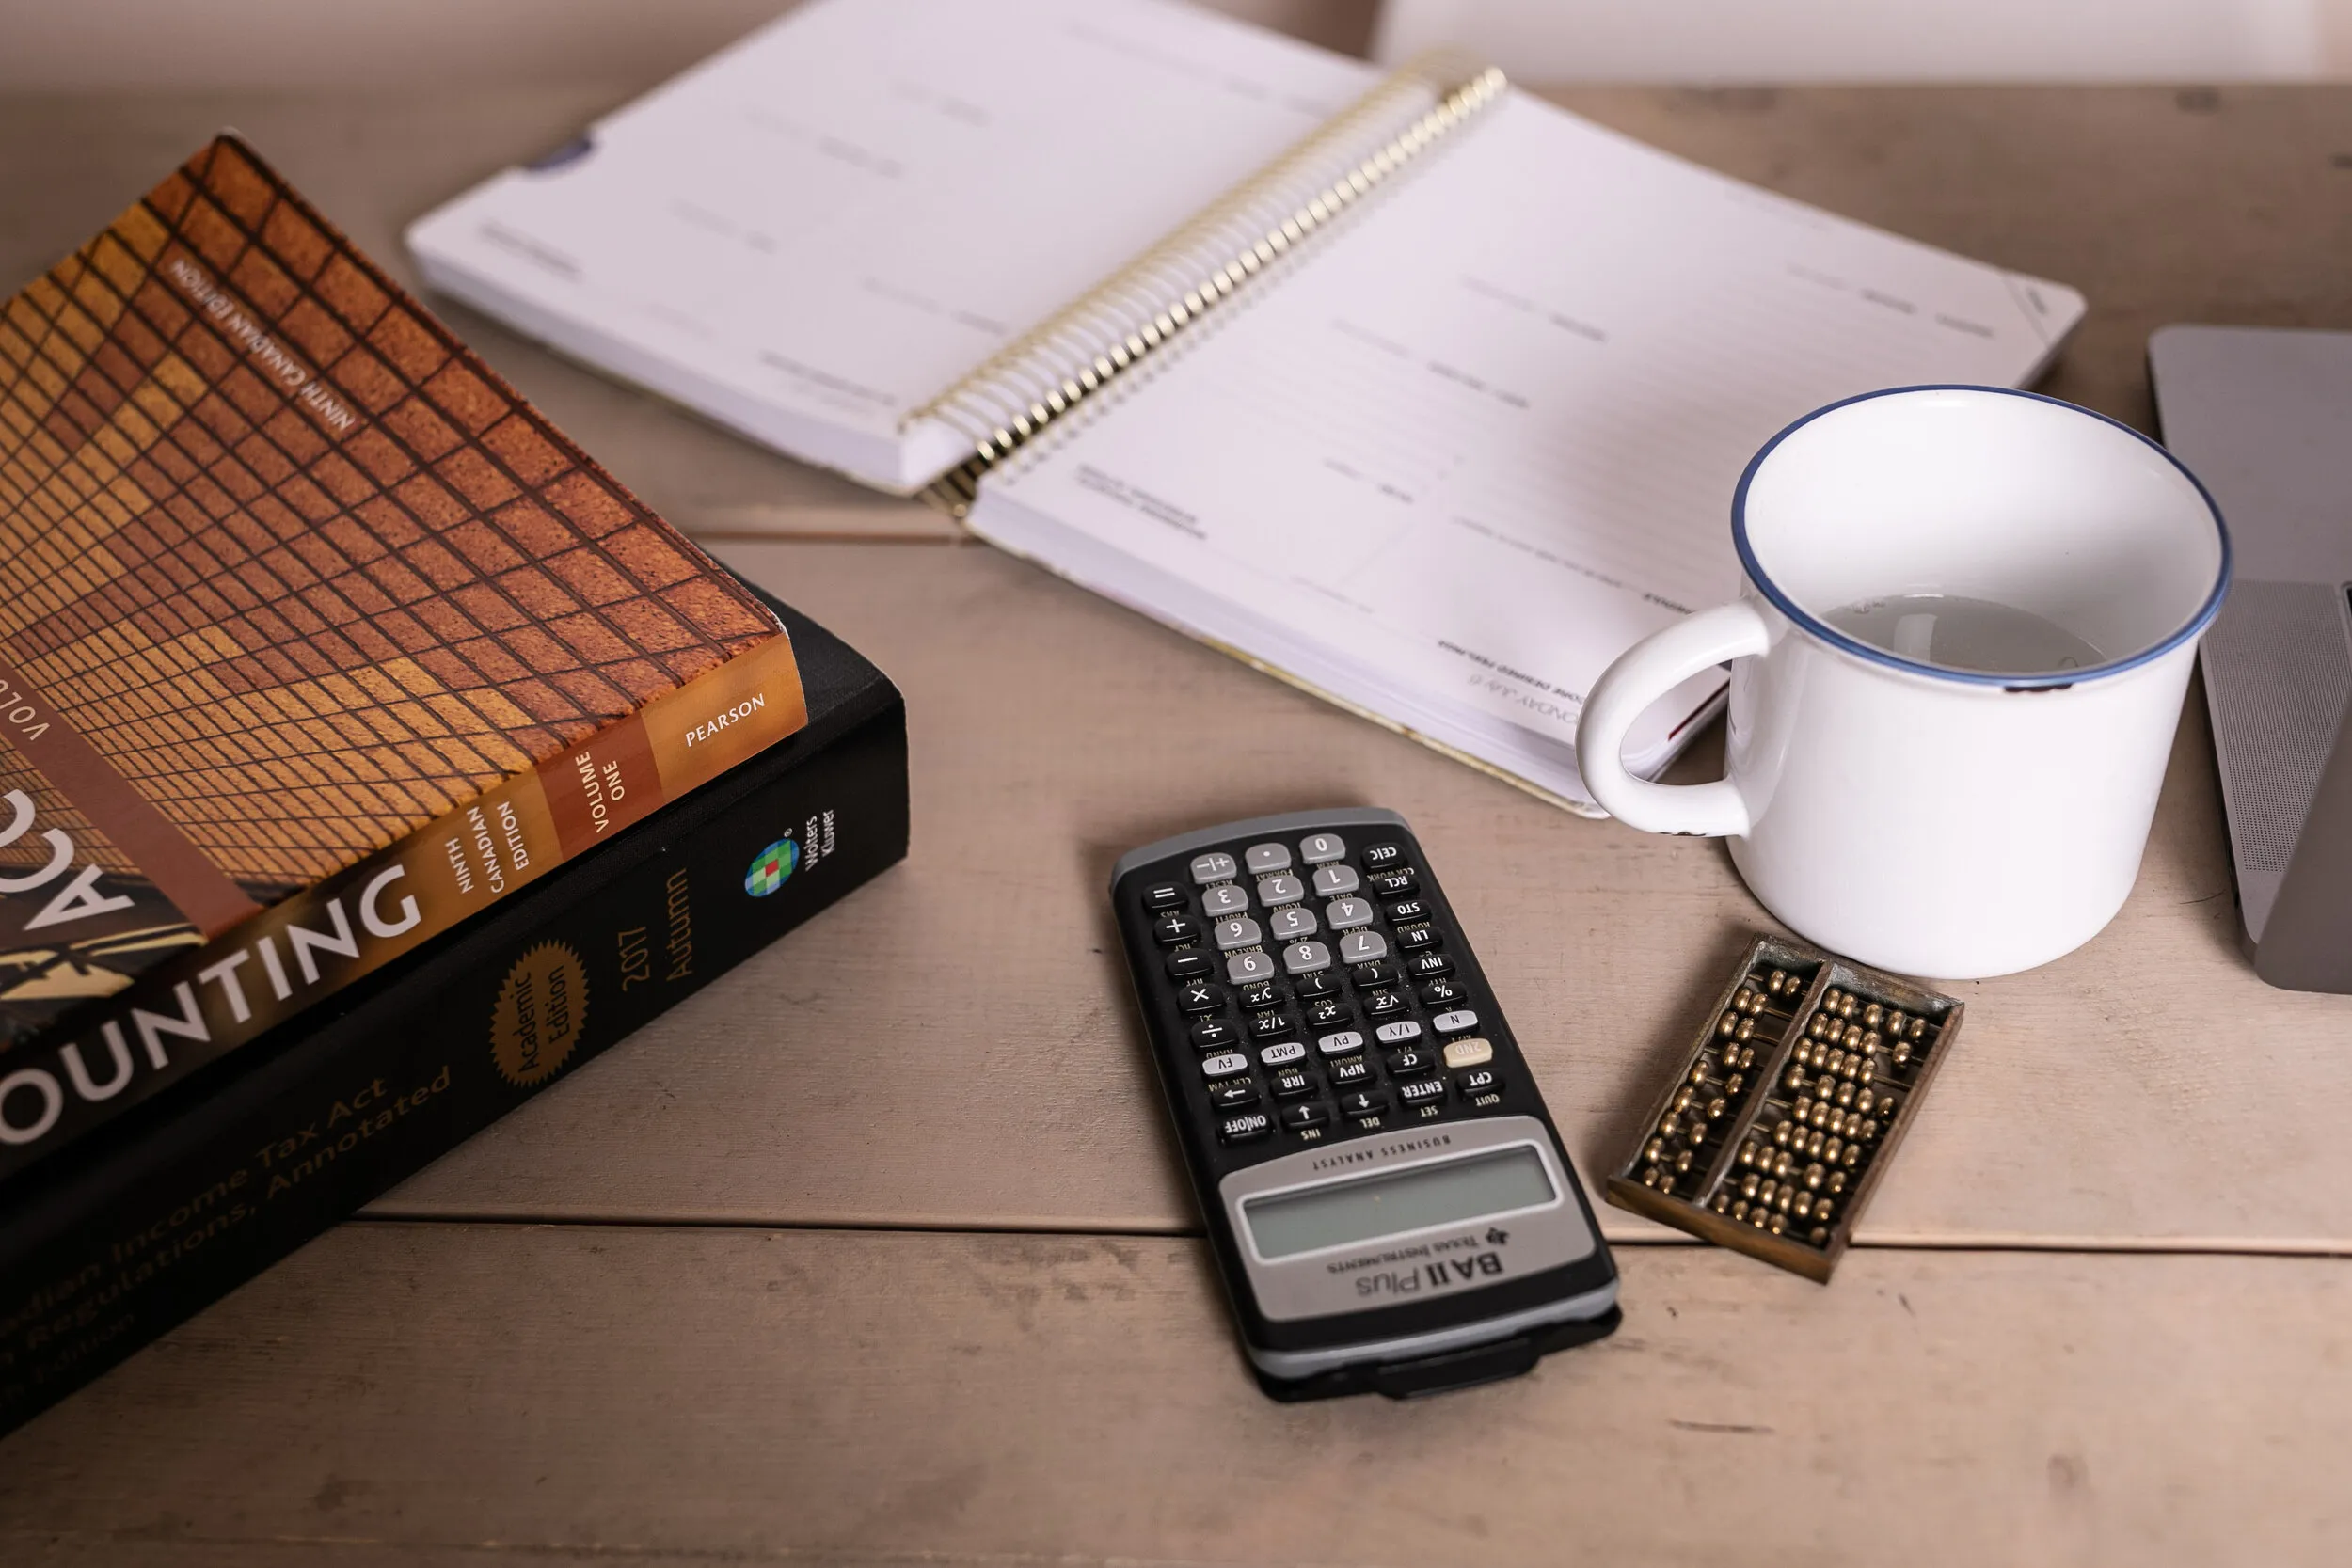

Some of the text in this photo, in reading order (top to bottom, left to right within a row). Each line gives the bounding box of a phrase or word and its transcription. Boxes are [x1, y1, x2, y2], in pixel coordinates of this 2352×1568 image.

[169, 258, 356, 431] NINTH CANADIAN EDITION
[685, 693, 765, 748] PEARSON
[603, 760, 626, 801] ONE
[575, 751, 610, 833] VOLUME
[497, 801, 529, 871] EDITION
[820, 809, 835, 857] Kluwer
[467, 805, 504, 894] CANADIAN
[803, 816, 818, 872] Wolters
[1315, 837, 1327, 852] 0
[447, 837, 474, 895] NINTH
[1328, 869, 1341, 884] 1
[1384, 875, 1408, 888] RCL
[1271, 879, 1286, 894] 2
[1217, 889, 1231, 904] 3
[1341, 902, 1354, 917] 4
[1397, 902, 1420, 914] STO
[666, 868, 693, 982] Autumn
[1286, 911, 1299, 927] 5
[1230, 922, 1243, 938] 6
[1410, 929, 1429, 942] LN
[1359, 935, 1370, 950] 7
[618, 926, 650, 991] 2017
[1298, 945, 1312, 960] 8
[1243, 956, 1257, 972] 9
[1422, 956, 1443, 970] INV
[1434, 985, 1453, 997] %
[0, 864, 422, 1145] OUNTING
[545, 964, 570, 1044] Edition
[513, 971, 539, 1073] Academic
[1450, 1015, 1460, 1024] N
[1389, 1024, 1410, 1037] I/Y
[1333, 1035, 1350, 1046] PV
[1455, 1041, 1481, 1055] 2ND
[1270, 1045, 1296, 1058] PMT
[1218, 1058, 1232, 1069] FV
[1402, 1053, 1417, 1066] CF
[1339, 1062, 1365, 1078] NPV
[1281, 1074, 1305, 1088] IRR
[1469, 1072, 1492, 1086] CPT
[1402, 1081, 1443, 1098] ENTER
[1475, 1094, 1500, 1107] QUIT
[1420, 1105, 1438, 1117] SET
[1359, 1117, 1381, 1129] DEL
[267, 1065, 451, 1200] Annotated
[1300, 1128, 1321, 1141] INS
[1311, 1135, 1451, 1171] BUSINESS ANALYST
[112, 1168, 249, 1264] Income
[255, 1121, 320, 1169] Tax
[326, 1077, 389, 1129] Act
[1450, 1252, 1504, 1282] BA
[1356, 1267, 1421, 1297] Plus
